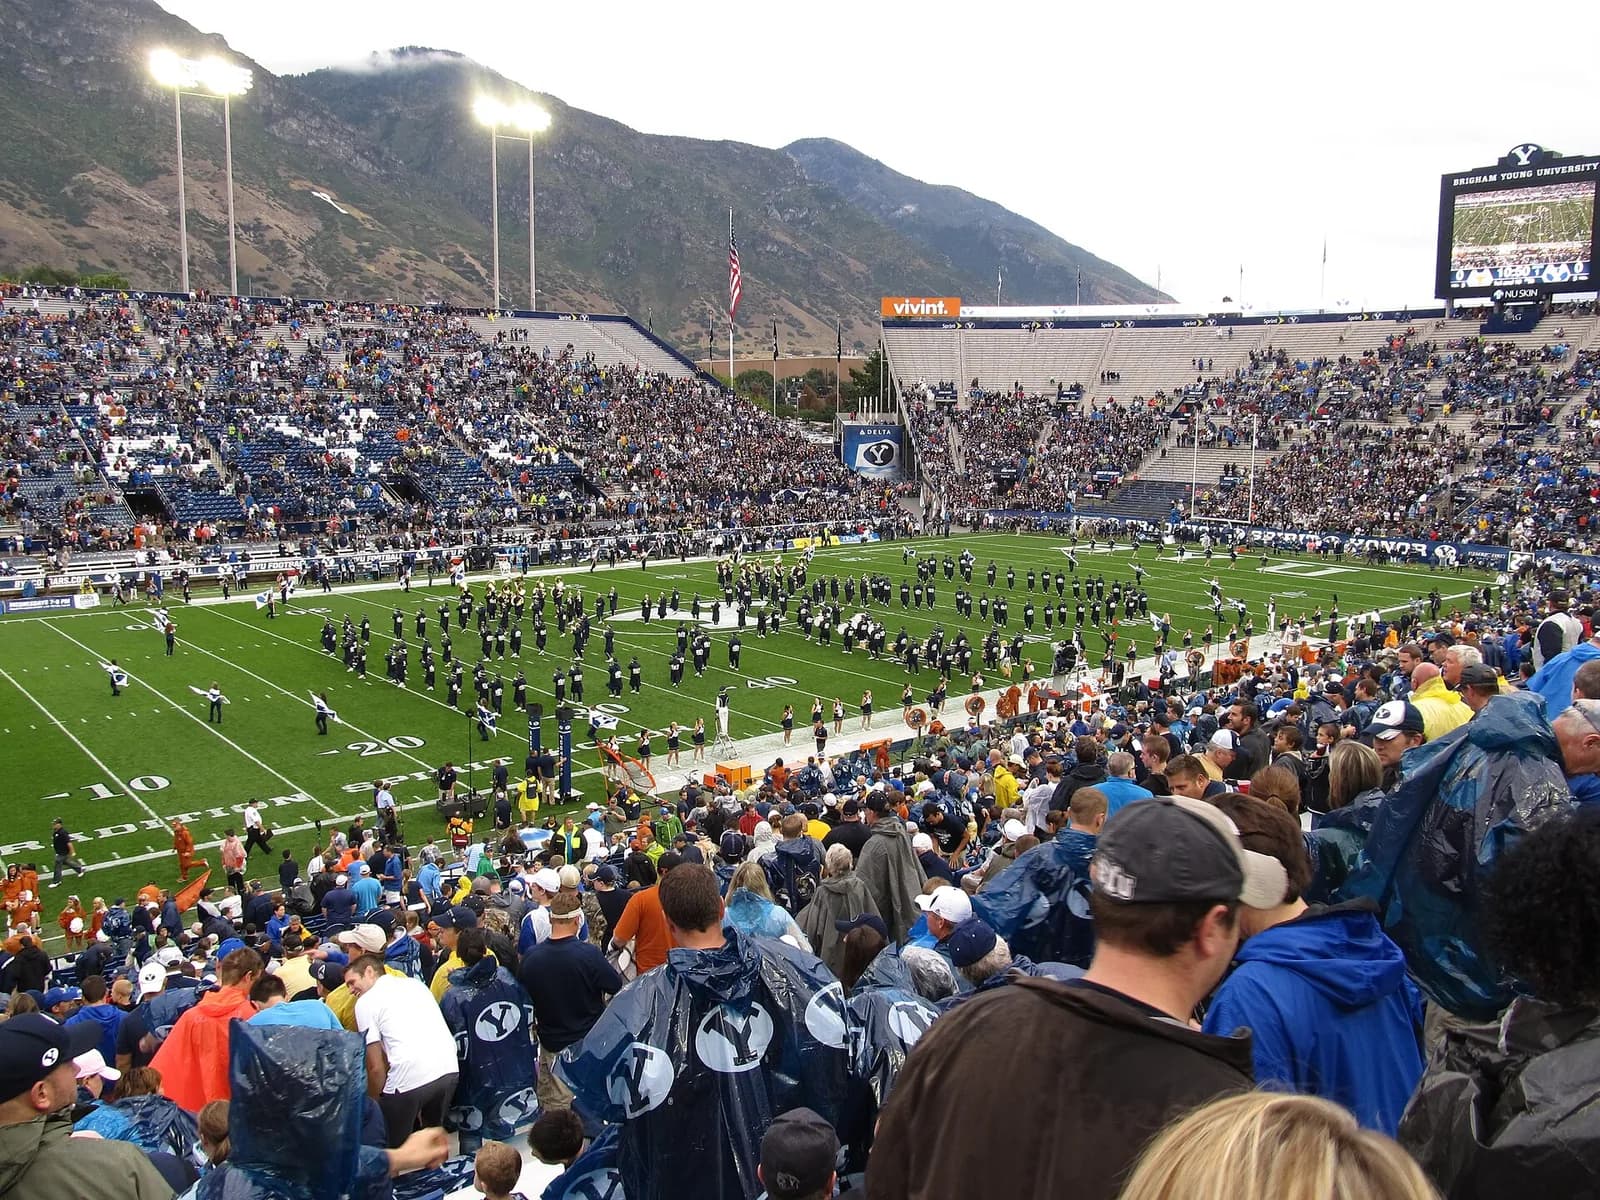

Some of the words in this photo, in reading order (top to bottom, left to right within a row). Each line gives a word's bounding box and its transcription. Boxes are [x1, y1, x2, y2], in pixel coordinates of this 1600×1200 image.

[1511, 145, 1538, 166] Y
[1453, 174, 1498, 186] BRIGHAM
[1500, 169, 1533, 181] YOUNG
[1536, 162, 1600, 177] UNIVERSITY
[1504, 290, 1518, 299] NU
[1518, 288, 1538, 298] SKIN
[893, 298, 949, 315] vivint.
[869, 444, 889, 464] Y
[747, 676, 798, 689] 40
[346, 735, 426, 757] 20
[79, 775, 172, 801] 10
[479, 1003, 513, 1038] Y
[703, 1003, 760, 1066] Y
